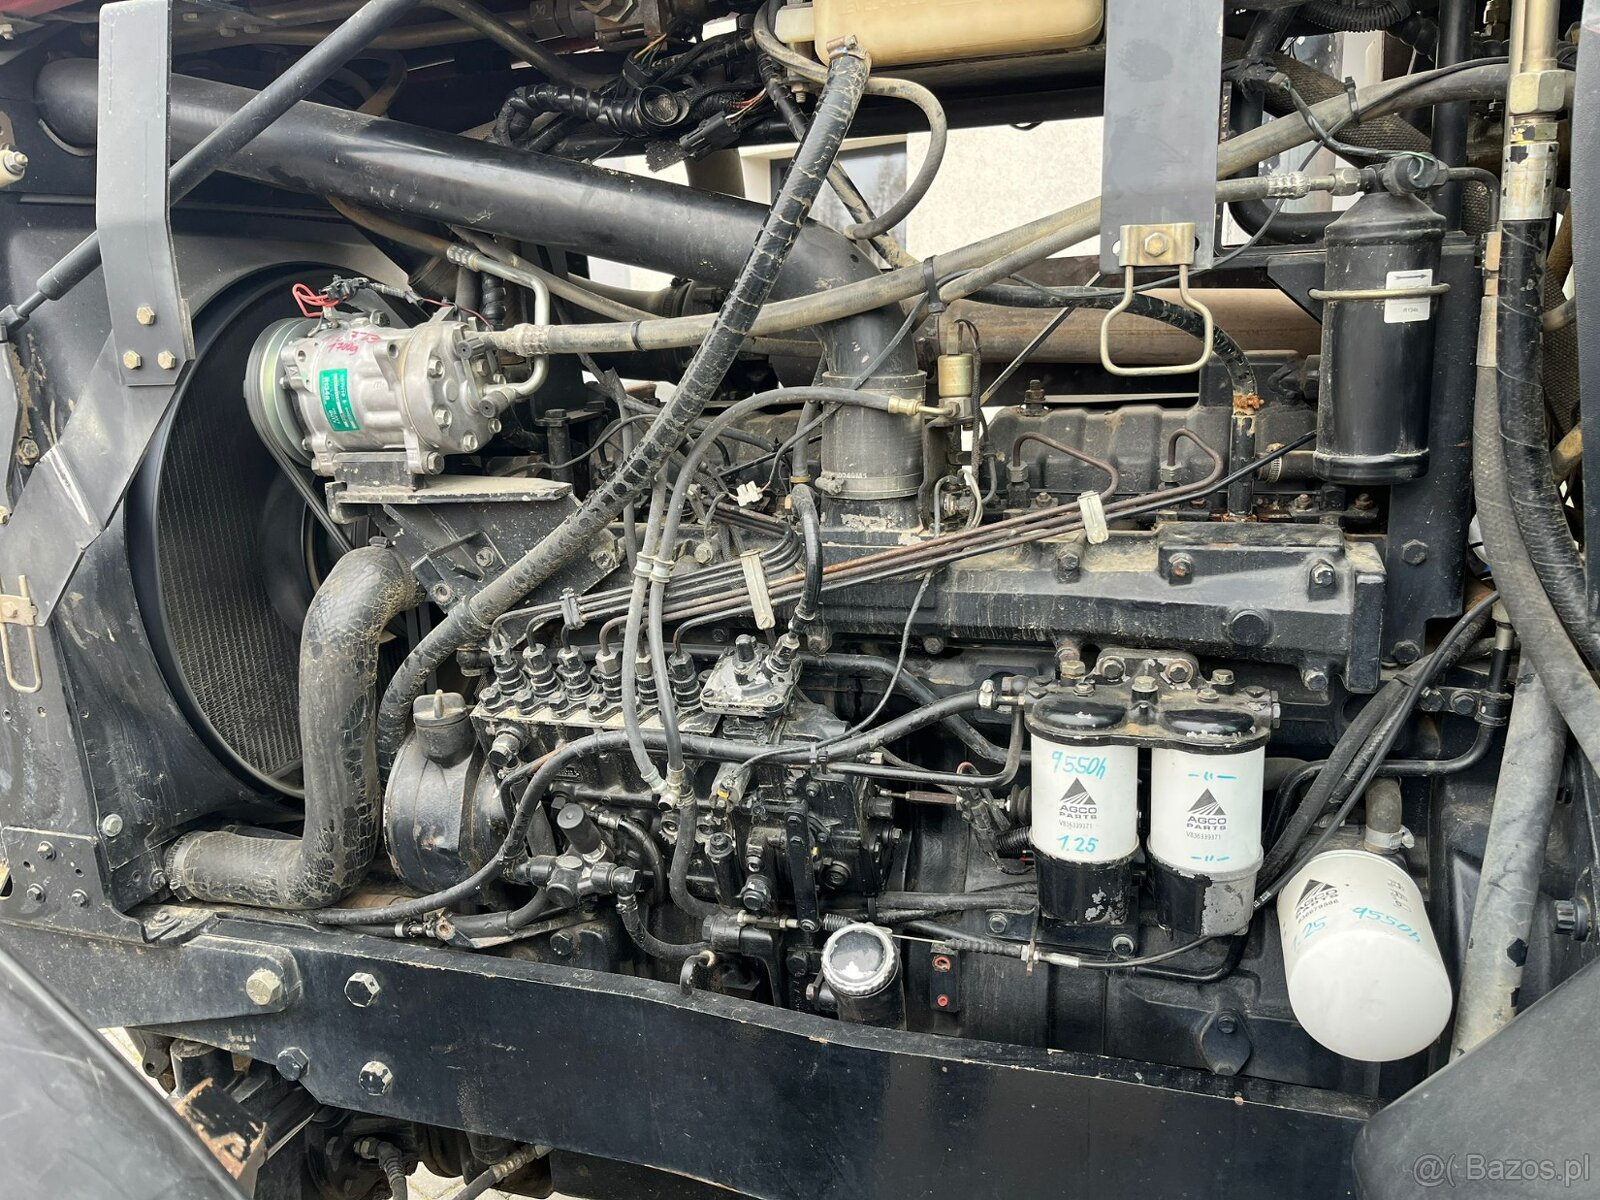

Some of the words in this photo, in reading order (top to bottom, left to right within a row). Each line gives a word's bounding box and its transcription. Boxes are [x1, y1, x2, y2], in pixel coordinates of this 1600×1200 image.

[1051, 750, 1108, 780] 9550h
[1059, 804, 1098, 815] AGCO
[1059, 811, 1098, 820] PARTS
[1186, 822, 1227, 831] PARTS
[1187, 815, 1228, 825] AGCO
[1056, 834, 1099, 853] 1.25
[1296, 888, 1338, 913] AGCO
[1296, 893, 1339, 920] PARTS
[1352, 905, 1422, 944] 9550h
